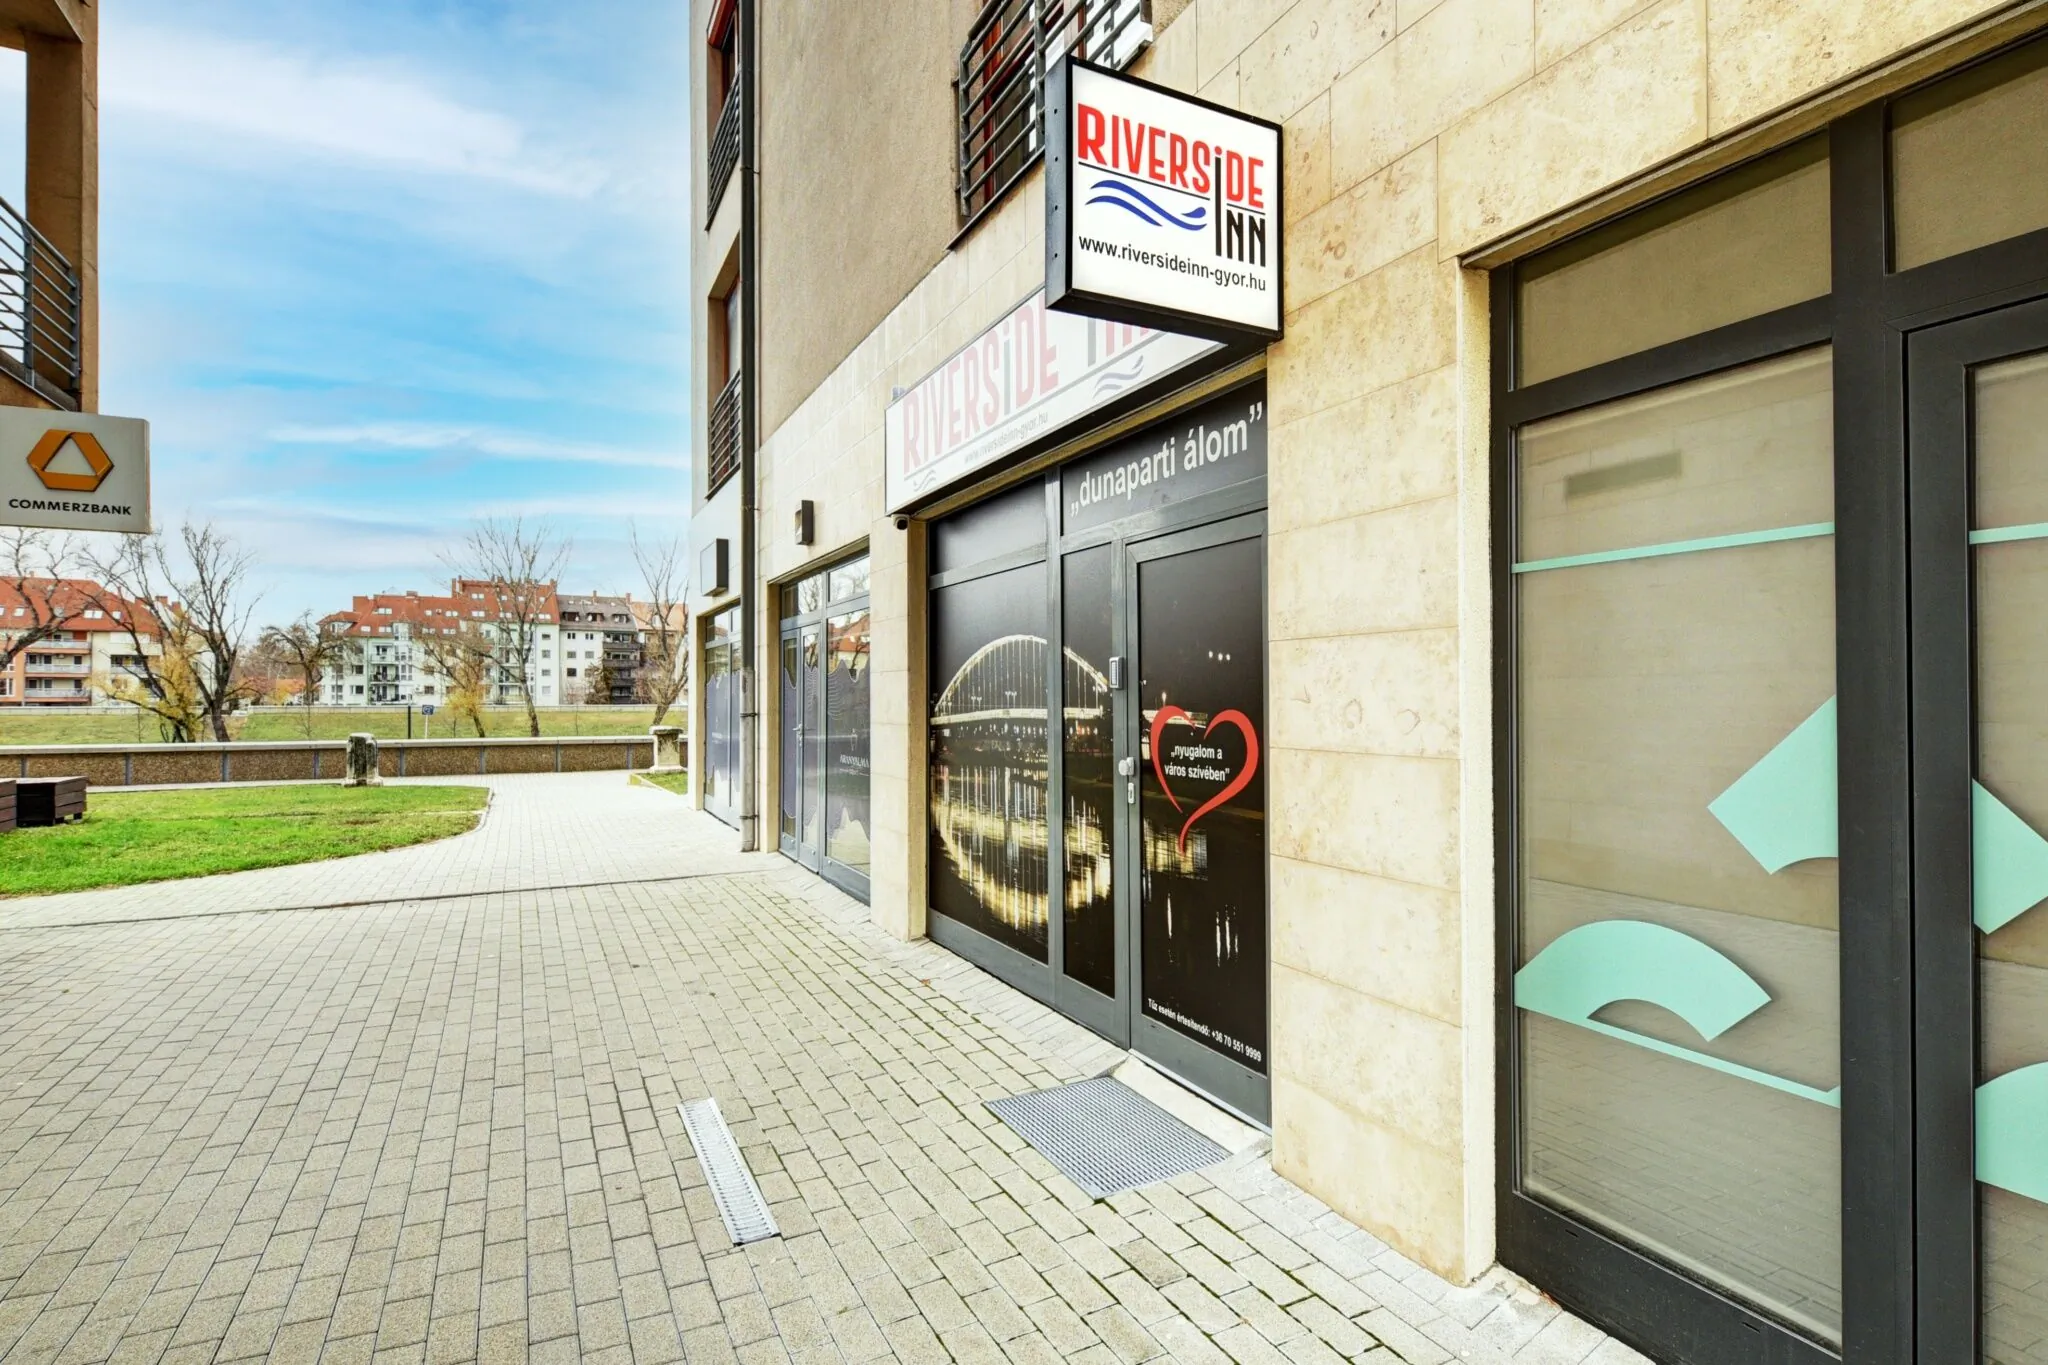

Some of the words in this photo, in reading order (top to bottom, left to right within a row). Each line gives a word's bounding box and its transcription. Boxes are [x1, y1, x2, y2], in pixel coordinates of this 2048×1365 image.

[1078, 235, 1267, 291] www.riversideinn-gyor.hu
[8, 498, 132, 516] COMMERZBANK
[1216, 749, 1223, 760] a
[1164, 762, 1187, 777] város
[1211, 1030, 1223, 1043] +36
[1223, 1034, 1232, 1048] 70
[1232, 1038, 1244, 1054] 551
